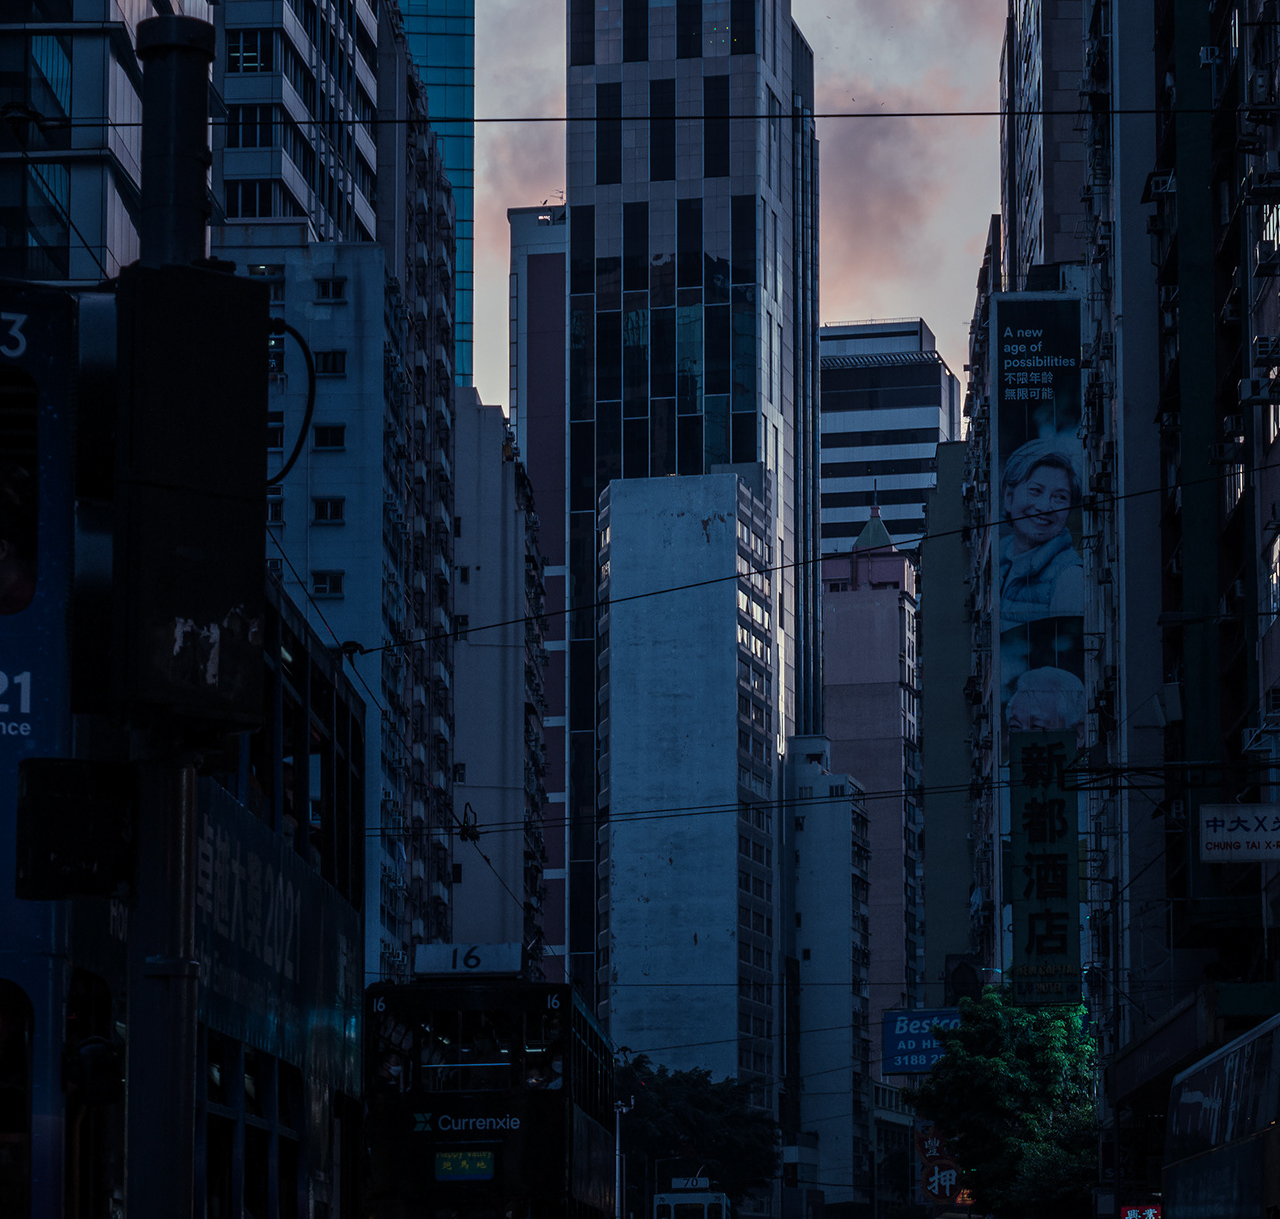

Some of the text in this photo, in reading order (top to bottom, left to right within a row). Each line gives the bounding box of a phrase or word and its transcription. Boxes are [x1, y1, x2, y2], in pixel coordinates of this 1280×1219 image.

[1003, 326, 1043, 338] A new
[1003, 340, 1043, 355] age of
[1003, 355, 1076, 370] possibilities
[1004, 371, 1054, 384] 不限年齡
[1004, 387, 1054, 400] 無限可能
[1021, 741, 1069, 956] 新都酒店
[1205, 840, 1241, 851] CHUNG
[1245, 840, 1261, 850] TAI
[450, 945, 481, 970] 16
[372, 995, 387, 1013] 16
[546, 993, 561, 1010] 16
[897, 1039, 916, 1051] AD
[894, 1054, 927, 1066] 3188
[437, 1114, 521, 1131] Currenxie
[682, 1177, 699, 1187] 70
[926, 1165, 958, 1198] 押
